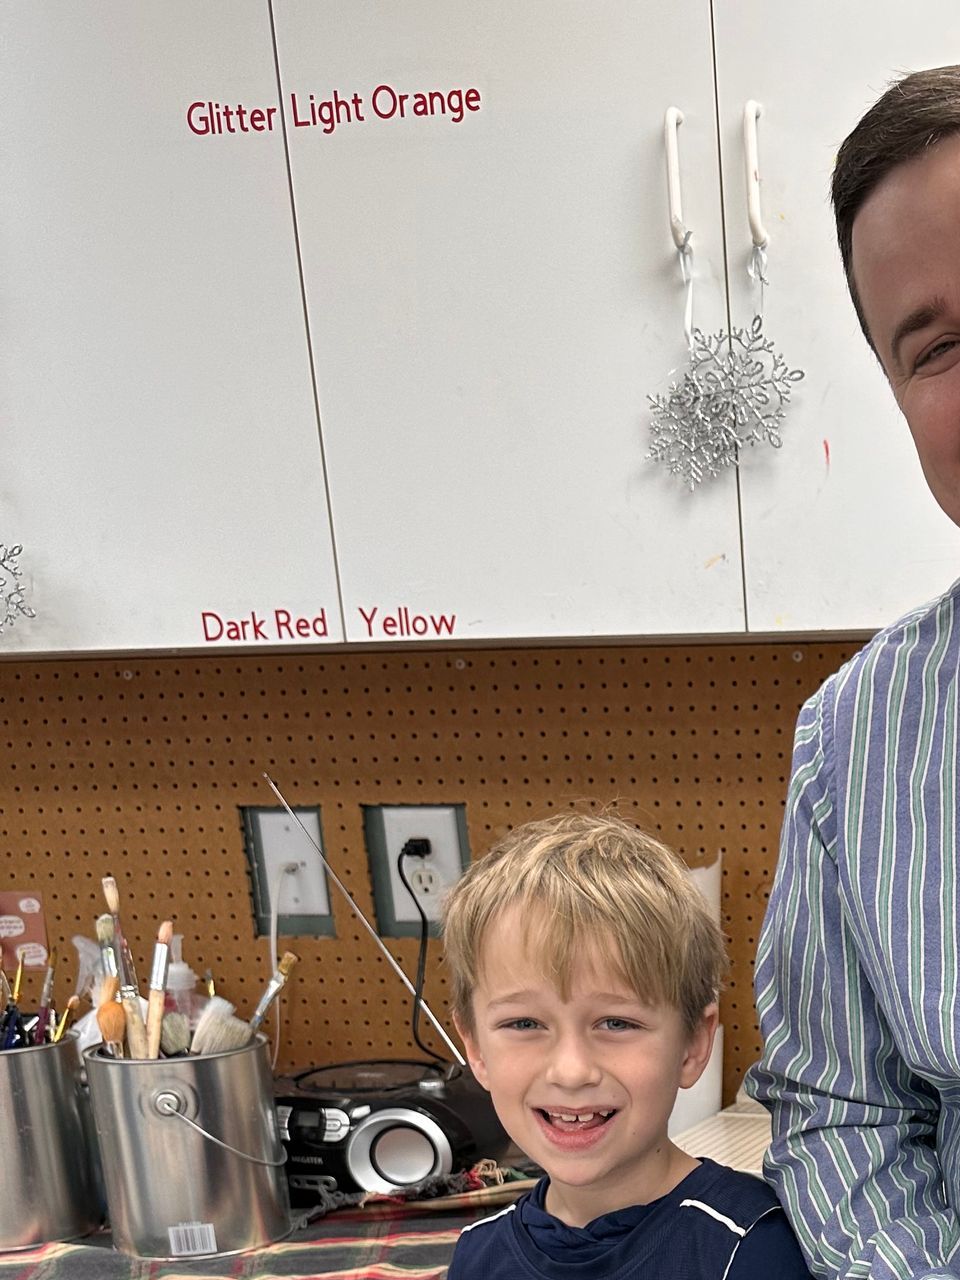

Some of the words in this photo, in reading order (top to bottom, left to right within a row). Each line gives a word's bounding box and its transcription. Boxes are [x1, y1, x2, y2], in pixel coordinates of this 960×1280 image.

[187, 101, 276, 135] Glitter
[290, 89, 365, 134] Light
[372, 85, 481, 123] Orange
[201, 611, 269, 641] Dark
[275, 607, 328, 639] Red
[358, 607, 456, 637] Yellow
